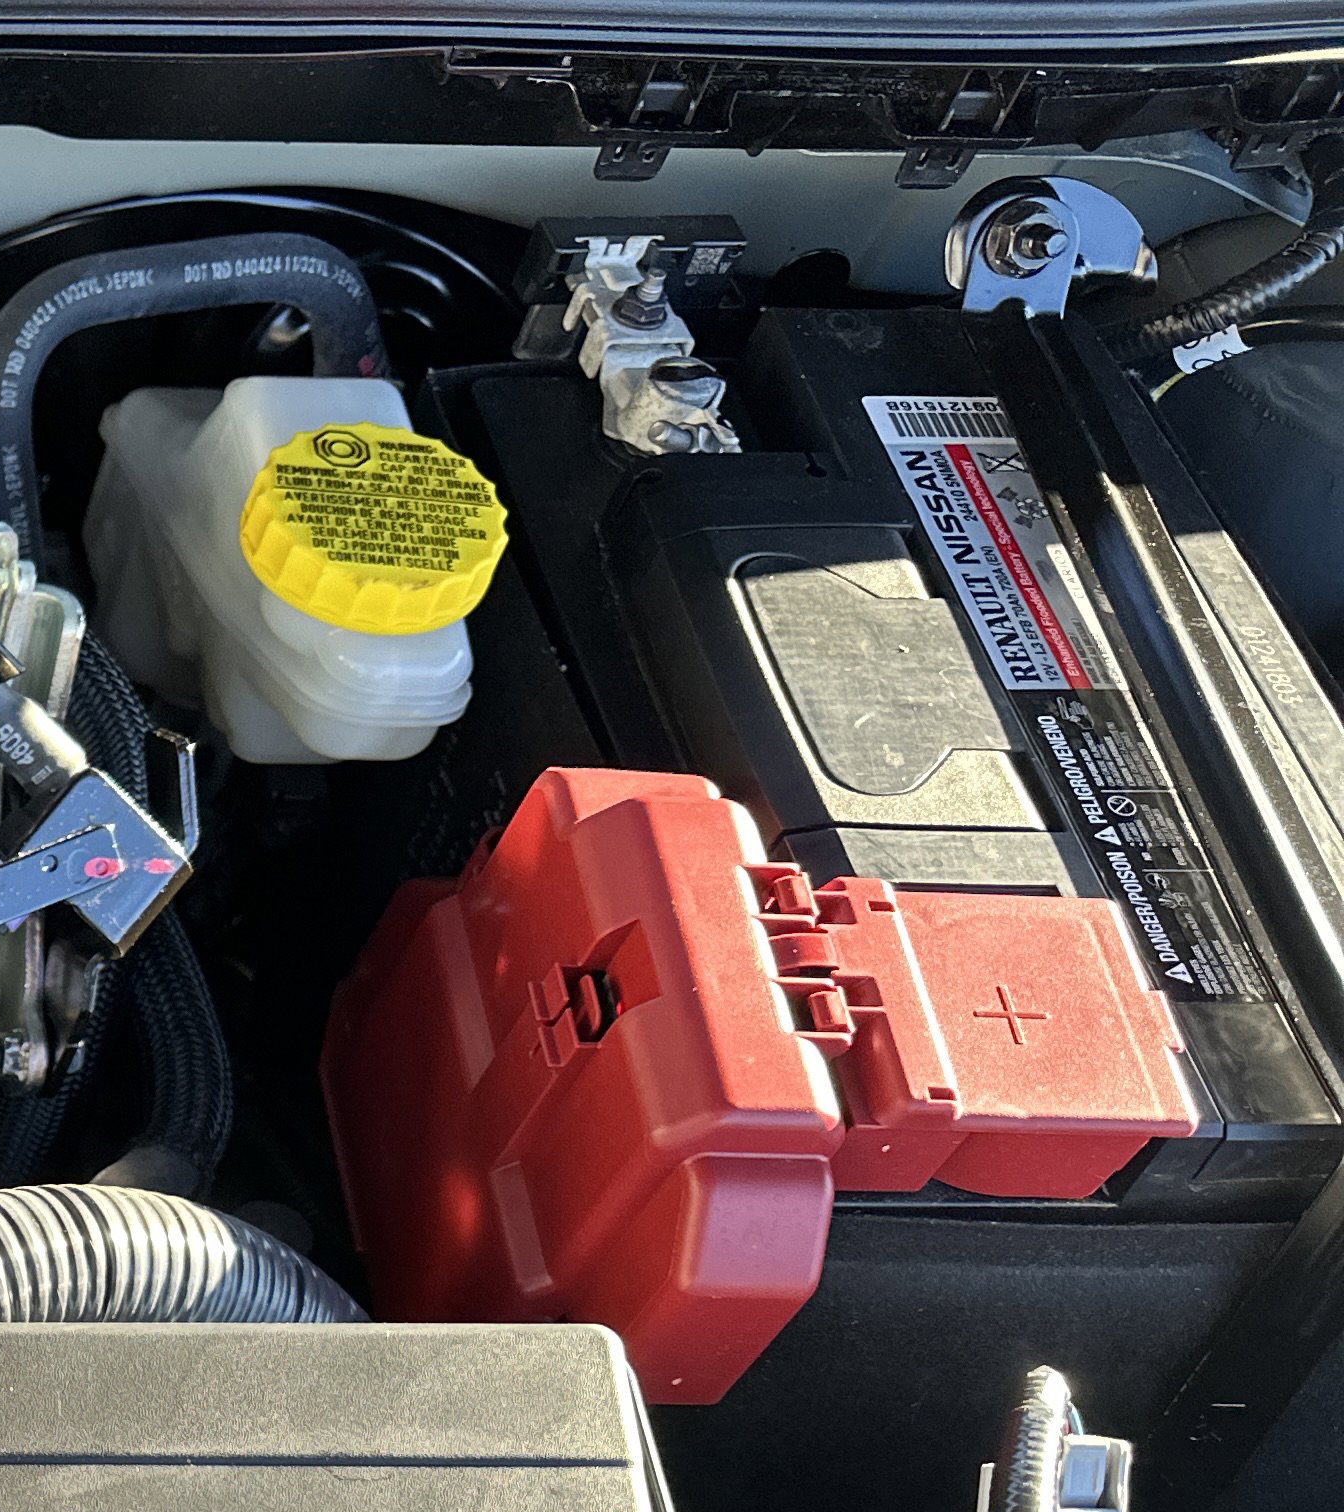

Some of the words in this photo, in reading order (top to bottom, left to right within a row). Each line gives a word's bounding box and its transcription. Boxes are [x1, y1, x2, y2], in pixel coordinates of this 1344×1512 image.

[381, 462, 406, 474] CAP
[412, 465, 459, 479] BEFORE
[423, 456, 467, 469] FILLER
[276, 475, 312, 488] FLUID
[317, 477, 353, 491] FROM
[357, 482, 366, 492] A
[370, 483, 419, 498] SEALED
[345, 469, 368, 481] USE
[371, 472, 403, 484] ONLY
[408, 475, 430, 487] DOT
[446, 480, 489, 493] BRAKE
[960, 460, 993, 510] technology
[300, 503, 356, 517] BOUCHON
[361, 508, 375, 519] DE
[379, 509, 469, 527] REMPLISSAGE
[397, 500, 461, 517] NETTOYER
[465, 506, 480, 518] LE
[899, 450, 981, 565] NISSAN
[287, 513, 330, 527] AVANT
[335, 517, 349, 528] DE
[431, 525, 487, 541] UTILISER
[311, 525, 385, 541] SEULEMENT
[390, 533, 406, 544] DU
[411, 535, 458, 549] LIQUIDE
[986, 511, 1013, 546] Special
[312, 538, 335, 550] DOT
[352, 542, 427, 558] PROVENANT
[327, 550, 402, 567] CONTENANT
[406, 557, 455, 573] SCELLÉ
[1008, 552, 1033, 587] Battery
[1024, 587, 1055, 627] Flooded
[961, 573, 1043, 683] RENAULT
[1031, 642, 1048, 656] L3
[1047, 628, 1080, 678] Enhanced
[1046, 664, 1060, 682] 12V
[1037, 715, 1108, 825] PELIGRO/VENENO
[1106, 851, 1180, 964] DANGER/POISON
